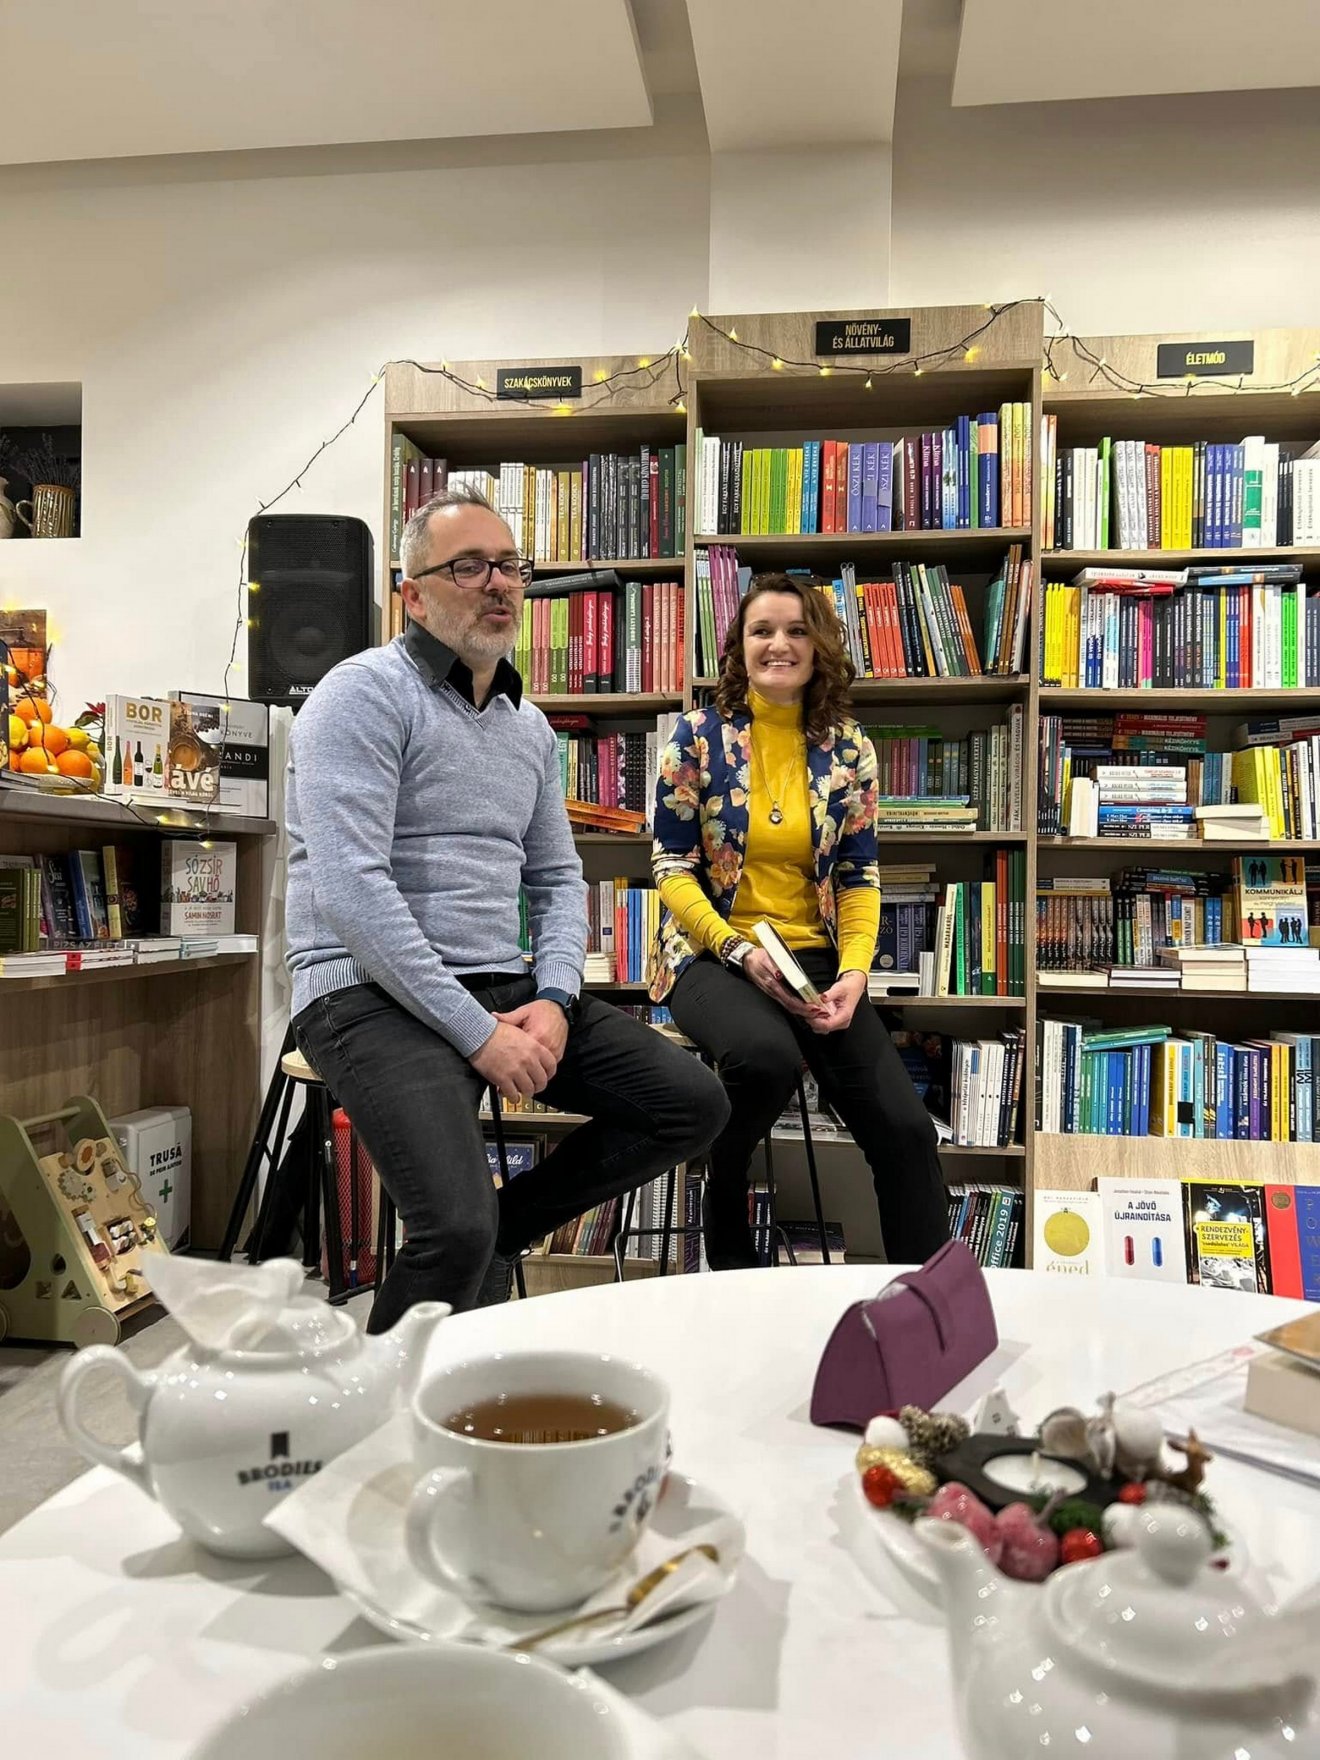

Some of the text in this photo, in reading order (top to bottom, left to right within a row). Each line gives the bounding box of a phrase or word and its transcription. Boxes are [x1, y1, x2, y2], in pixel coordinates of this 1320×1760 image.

[845, 323, 882, 336] NÖVÉNY-
[832, 335, 895, 349] ÉS ÁLLATVILÁG
[1185, 351, 1226, 365] ÉLETMÓD
[504, 376, 572, 389] SZAKÁCSKÖNYVEK
[126, 702, 162, 723] BOR
[170, 764, 214, 792] ávé
[200, 855, 223, 875] ZSÍR
[187, 876, 206, 893] SAV
[1245, 888, 1303, 896] KOMMUNIKÁLJ
[1128, 1200, 1157, 1210] A JÖVŐ
[1114, 1210, 1172, 1222] ÚJRAINDÍTÁSA
[996, 1209, 1009, 1237] 2019
[1201, 1225, 1249, 1234] RENDEZVÉNY-
[1202, 1233, 1242, 1241] SZERVEZÉS
